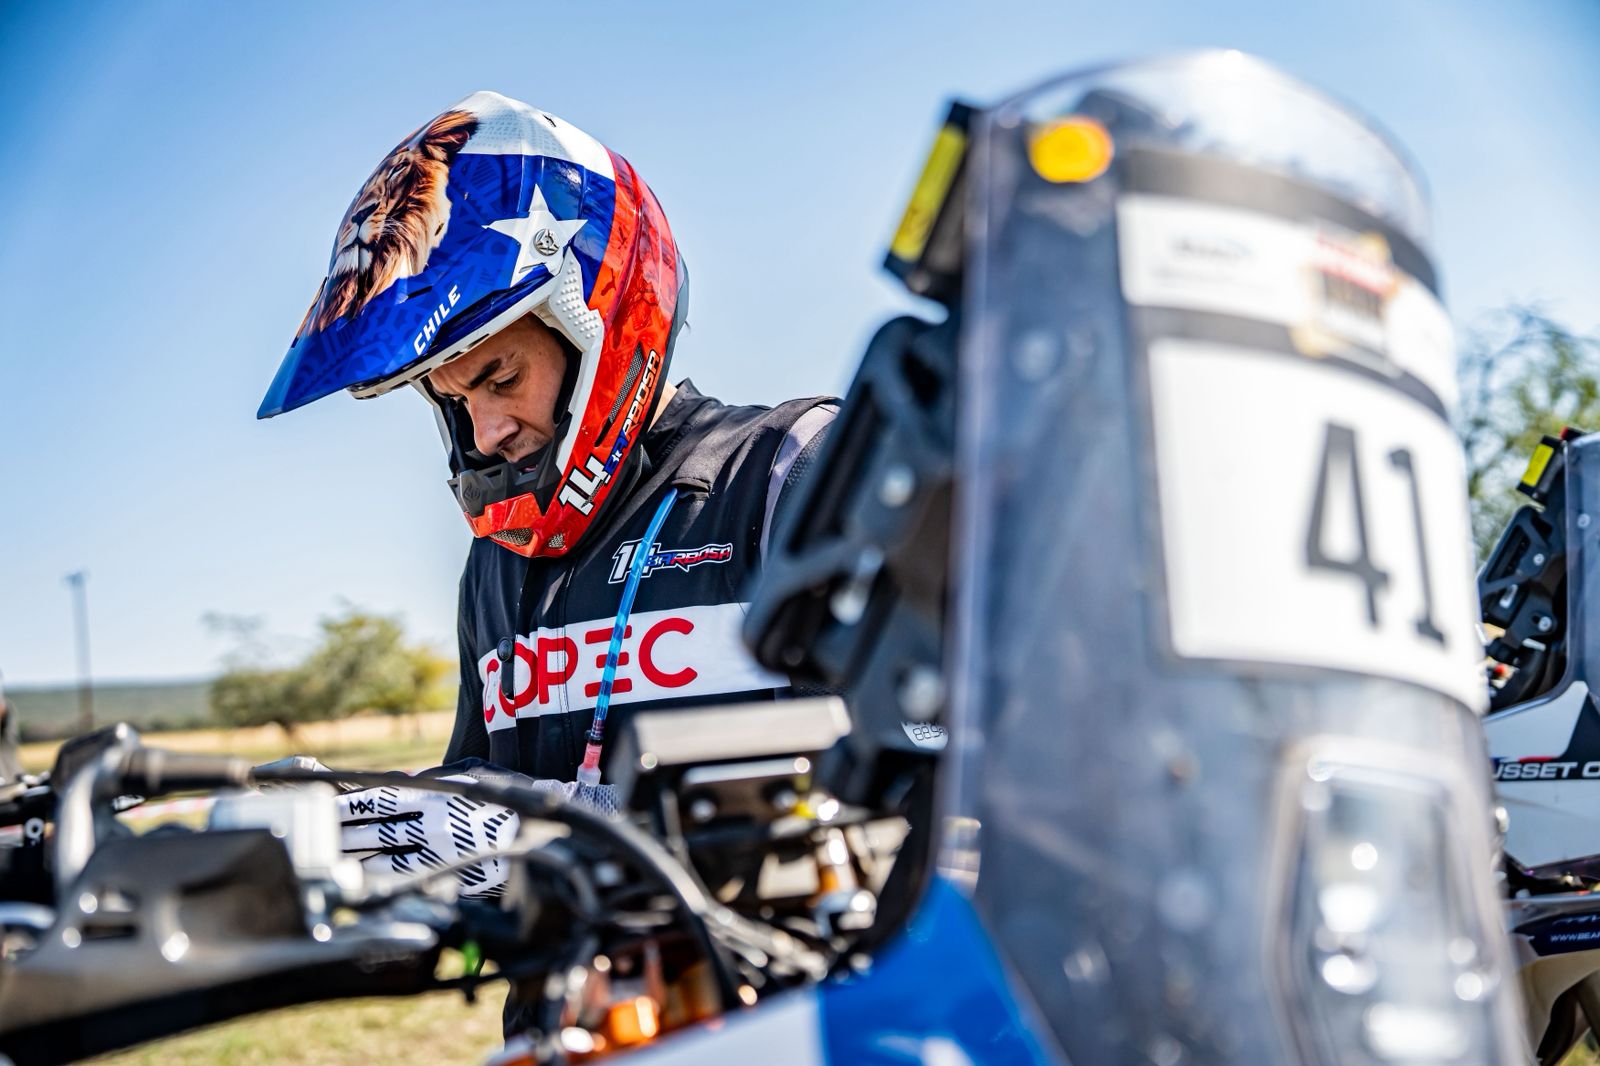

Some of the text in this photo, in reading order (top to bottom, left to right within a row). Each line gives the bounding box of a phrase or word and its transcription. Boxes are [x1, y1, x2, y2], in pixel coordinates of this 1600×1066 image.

[413, 284, 461, 356] CHILE
[557, 453, 611, 517] 14
[1304, 420, 1448, 646] 41
[483, 616, 699, 724] COPEC
